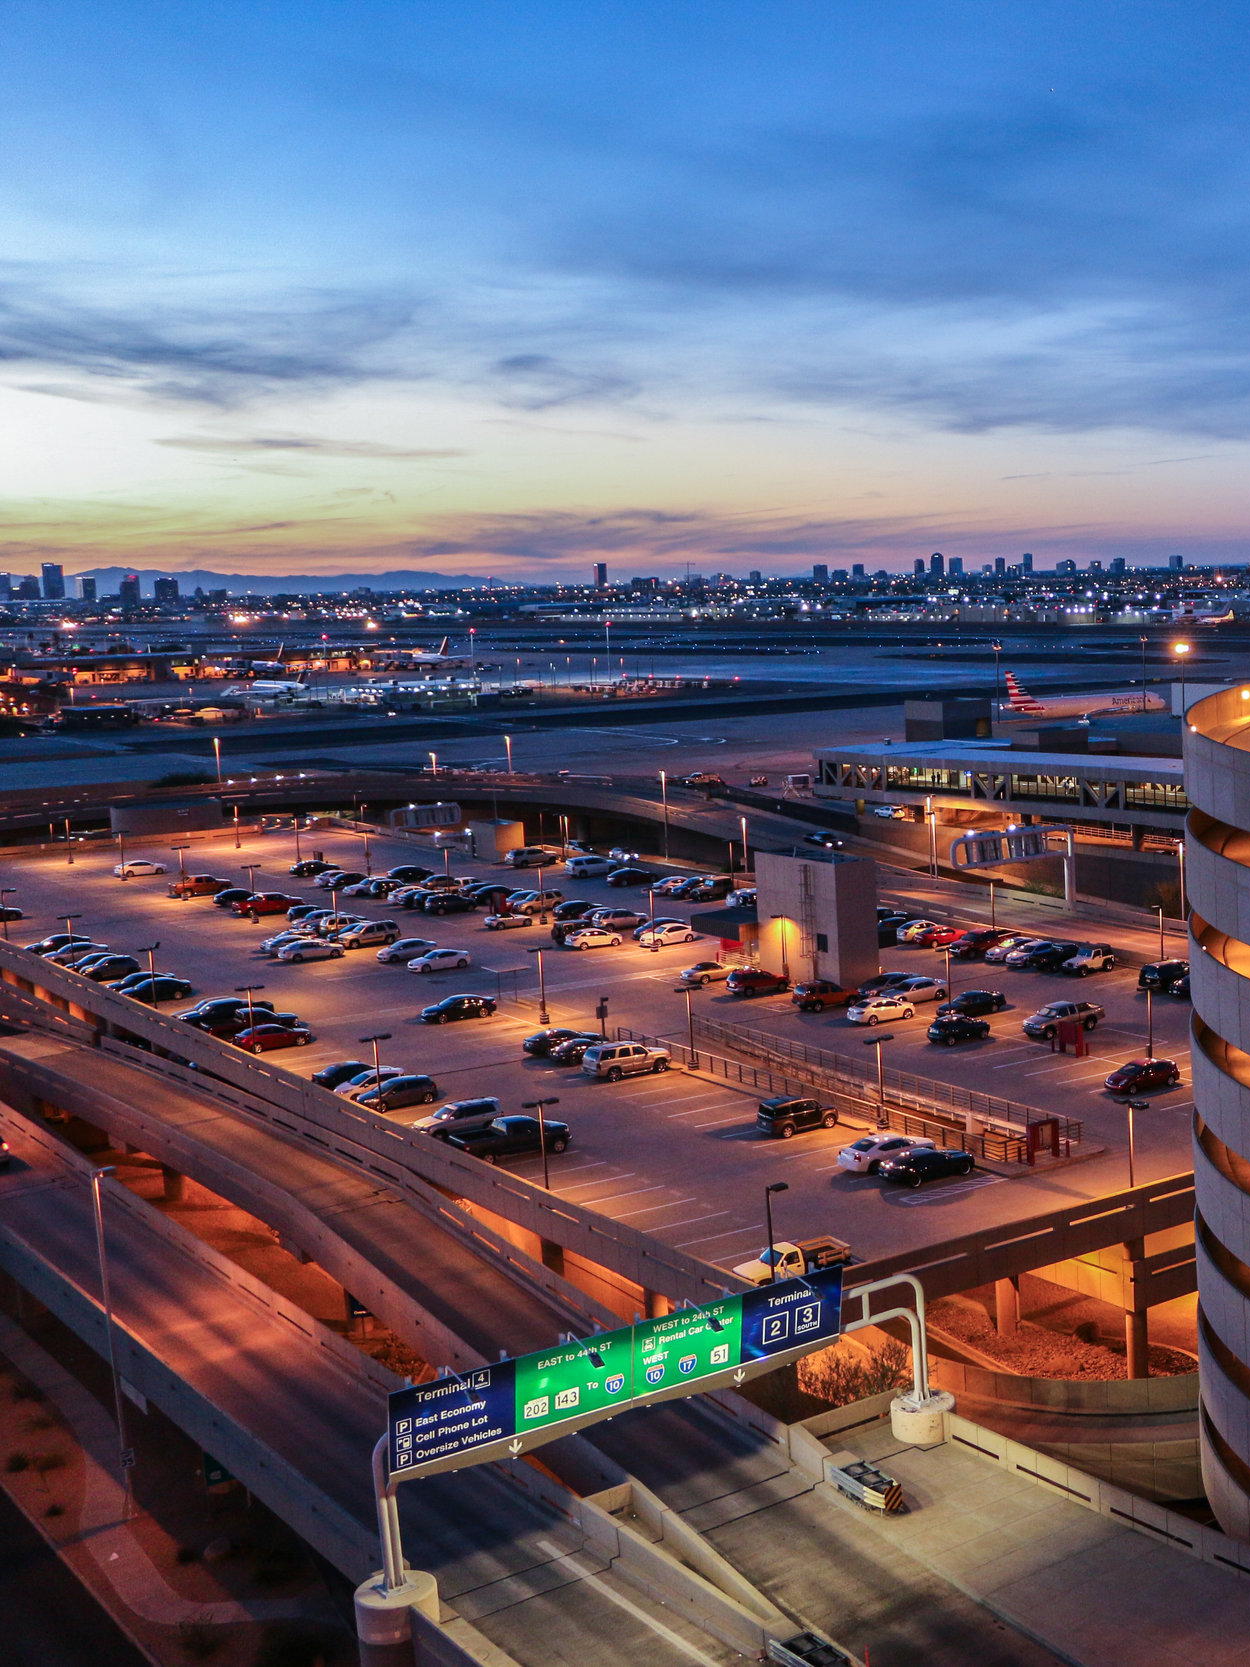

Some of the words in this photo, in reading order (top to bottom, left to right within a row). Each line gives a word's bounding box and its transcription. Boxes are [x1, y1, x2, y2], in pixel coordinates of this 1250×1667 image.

[653, 1319, 679, 1333] WEST
[681, 1317, 690, 1325] to
[712, 1305, 724, 1316] ST
[658, 1329, 686, 1345] Rental
[688, 1324, 704, 1336] Car
[705, 1316, 734, 1330] Cter
[770, 1320, 781, 1336] 2
[802, 1307, 813, 1323] 3
[797, 1320, 818, 1332] SOUTH
[537, 1356, 563, 1370] EAST
[565, 1353, 575, 1362] to
[599, 1341, 612, 1352] ST
[642, 1350, 669, 1365] WEST
[649, 1370, 660, 1382] 10
[683, 1360, 692, 1371] 17
[713, 1348, 726, 1362] 51
[416, 1378, 471, 1402] Terminal
[526, 1402, 547, 1417] 202
[557, 1391, 577, 1407] 143
[586, 1381, 599, 1390] To
[609, 1380, 620, 1391] 10
[399, 1421, 408, 1433] P
[415, 1413, 438, 1427] East
[440, 1400, 487, 1420] Economy
[415, 1430, 435, 1443] Cell
[438, 1420, 469, 1436] Phone
[471, 1415, 488, 1427] Lot
[400, 1454, 409, 1465] P
[416, 1440, 459, 1459] Oversize
[461, 1427, 502, 1445] Vehicles
